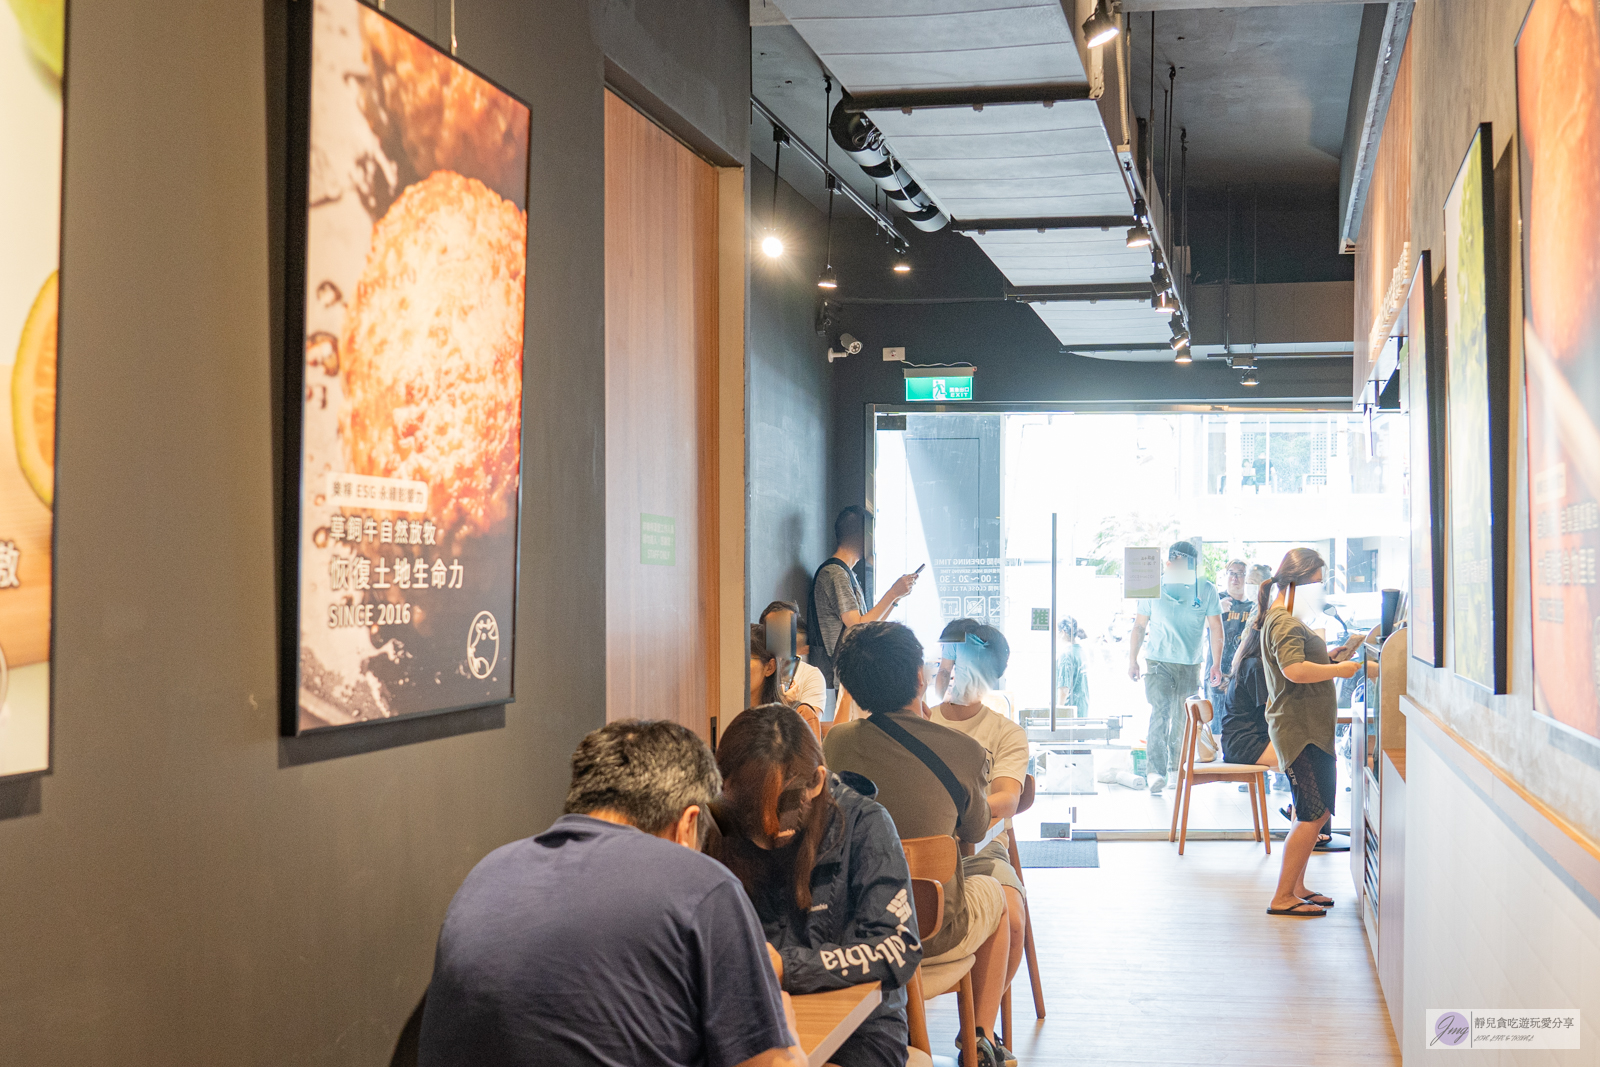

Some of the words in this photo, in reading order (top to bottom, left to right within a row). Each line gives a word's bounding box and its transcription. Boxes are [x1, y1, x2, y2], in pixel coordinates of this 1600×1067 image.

[356, 484, 376, 499] ESG
[330, 516, 437, 546] 草飼牛自然放牧
[330, 557, 464, 590] 恢復土地生命力
[328, 604, 375, 628] SINCE
[377, 602, 412, 626] 2016
[1032, 609, 1048, 625] 推
